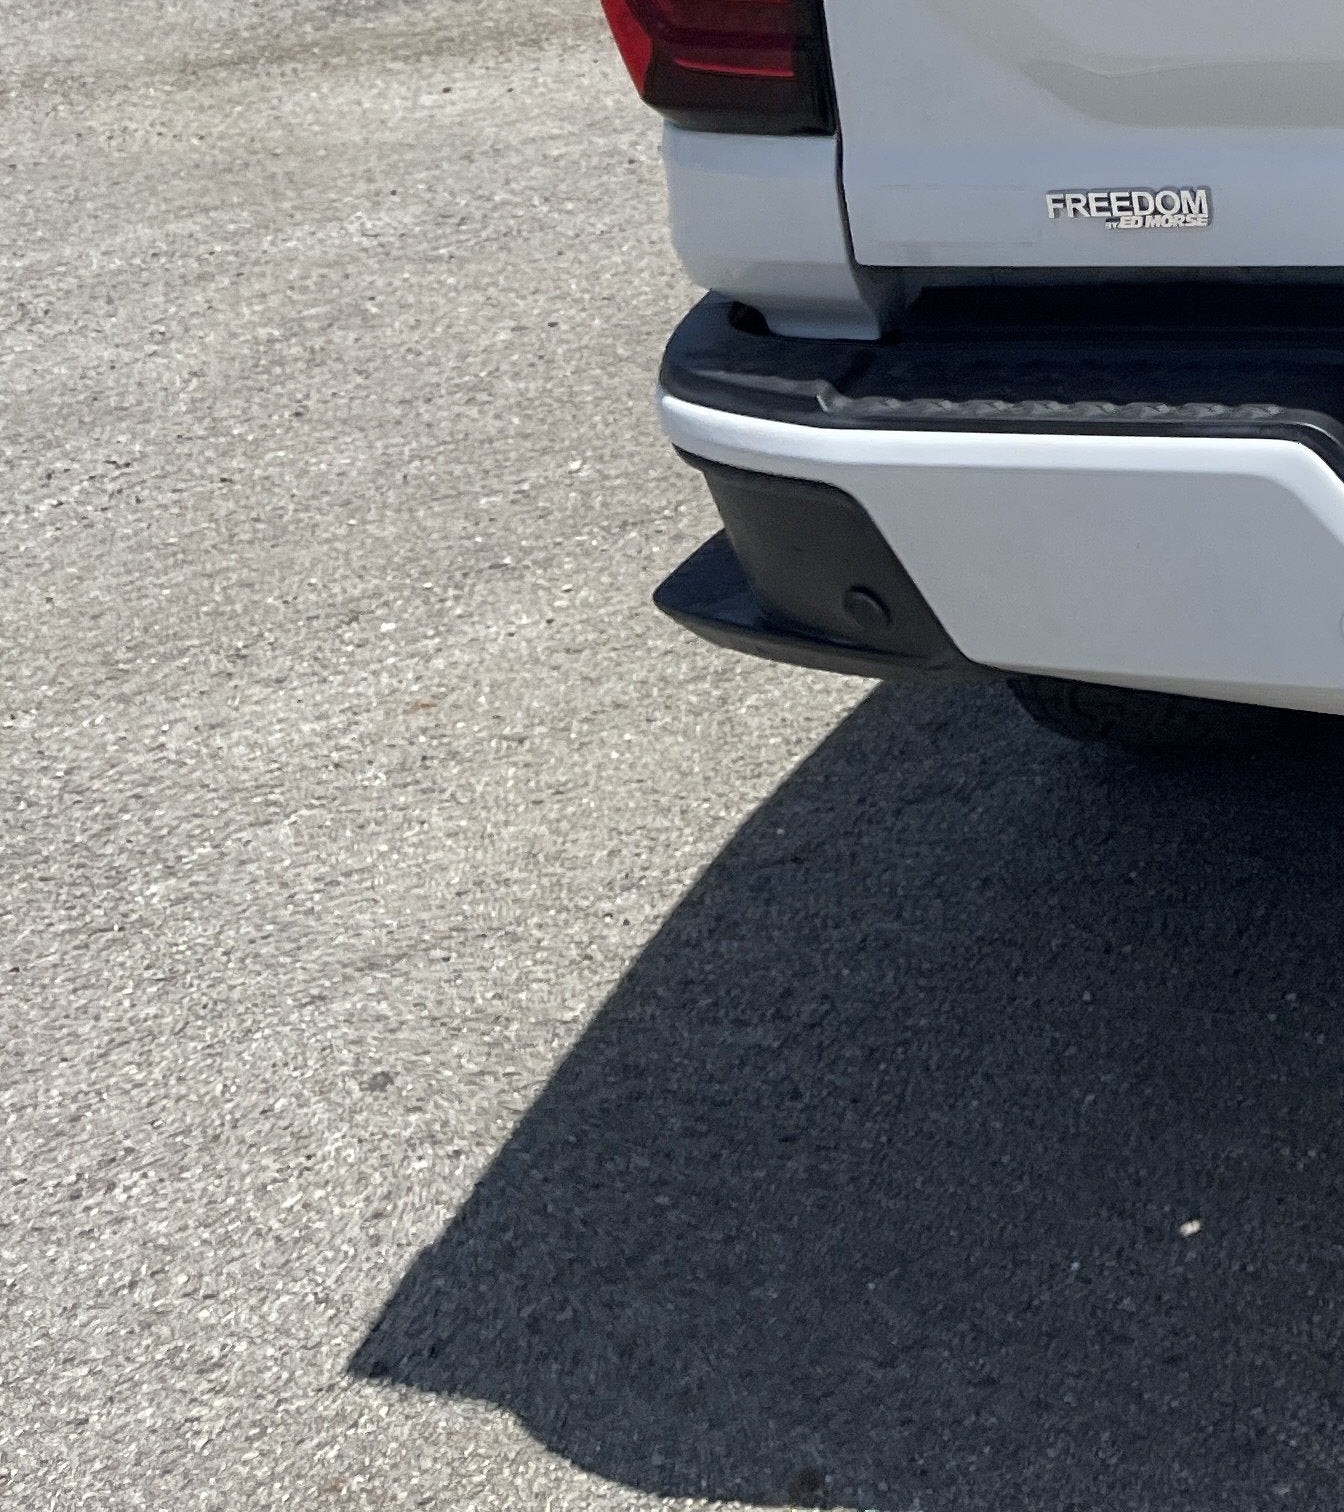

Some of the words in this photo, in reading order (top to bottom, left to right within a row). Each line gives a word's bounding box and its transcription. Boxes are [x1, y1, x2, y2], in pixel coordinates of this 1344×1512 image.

[1046, 189, 1209, 218] FREEDOM
[1118, 216, 1143, 229] ED
[1145, 214, 1208, 228] MORSE
